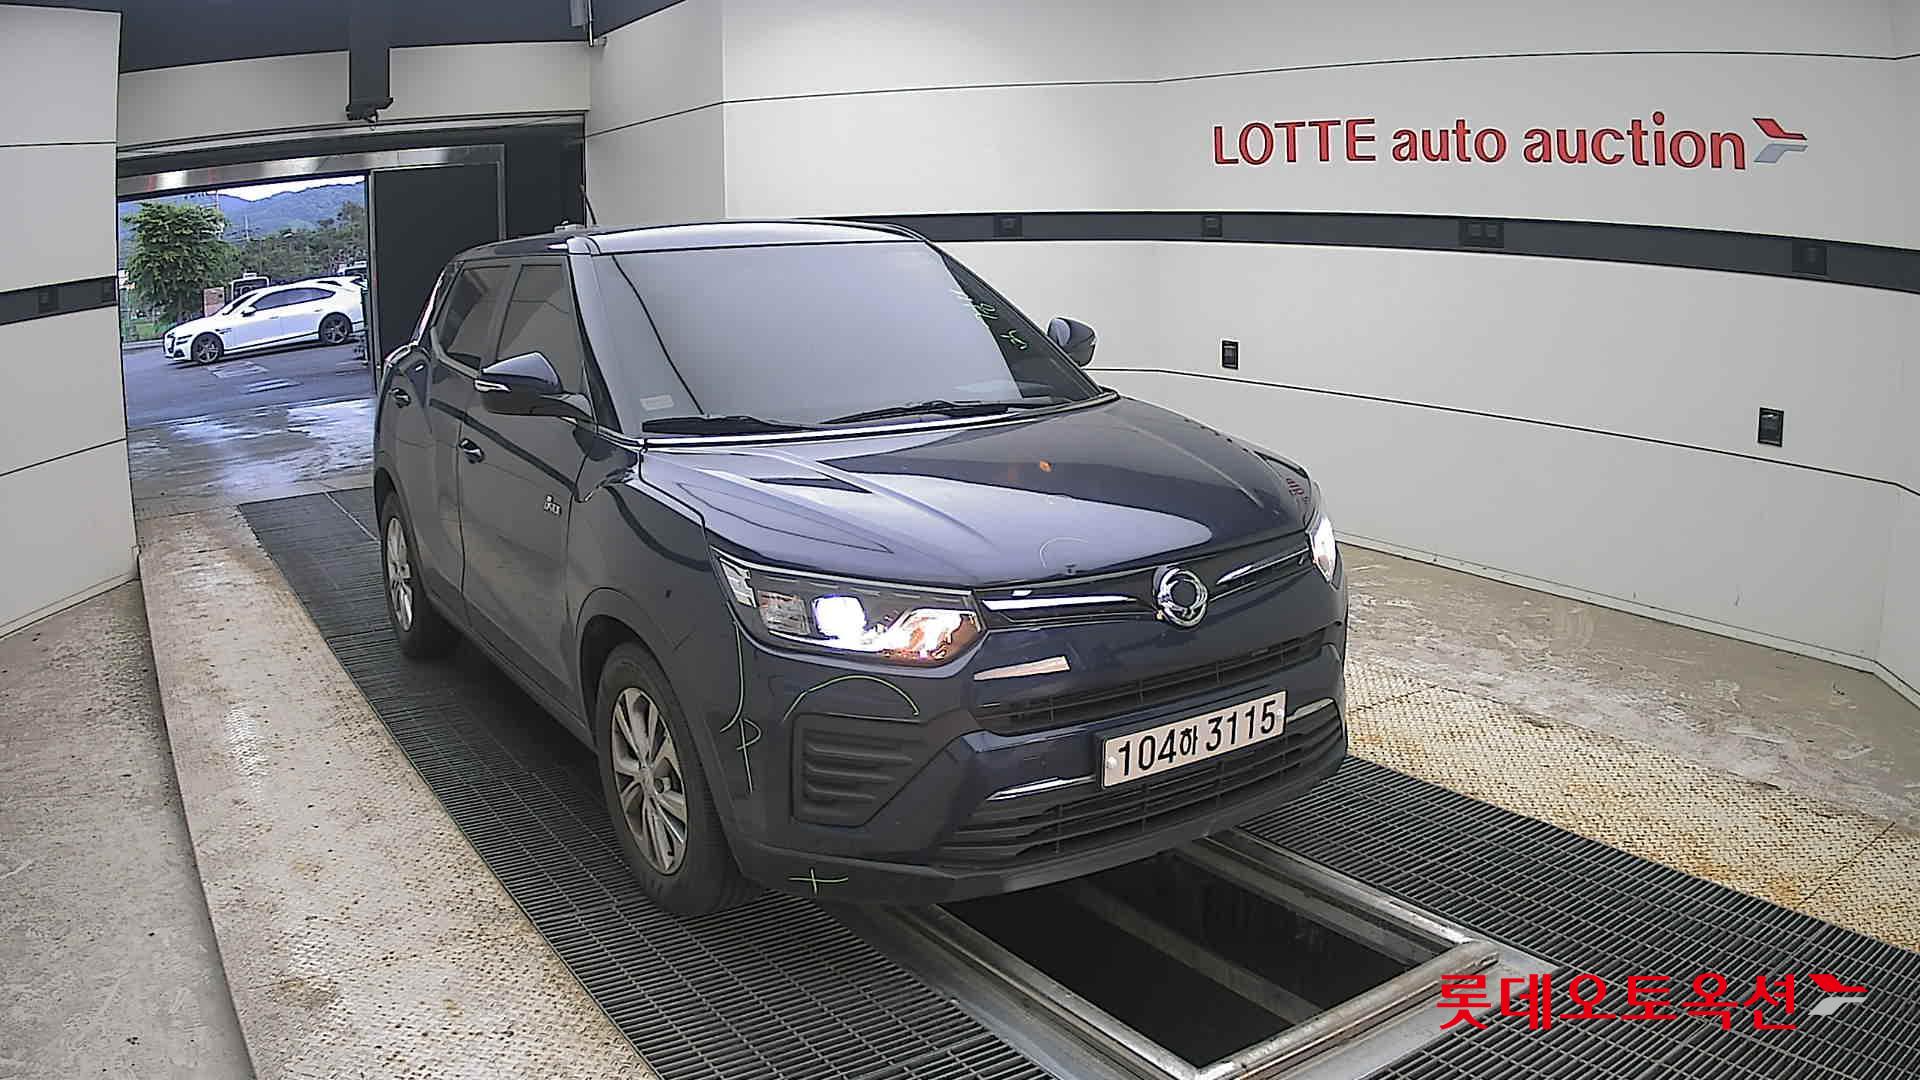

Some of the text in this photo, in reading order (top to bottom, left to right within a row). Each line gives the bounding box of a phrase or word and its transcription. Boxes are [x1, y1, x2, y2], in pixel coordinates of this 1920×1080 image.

[1213, 111, 1747, 171] LOTTE auto auction
[1118, 699, 1277, 777] 104하 3115
